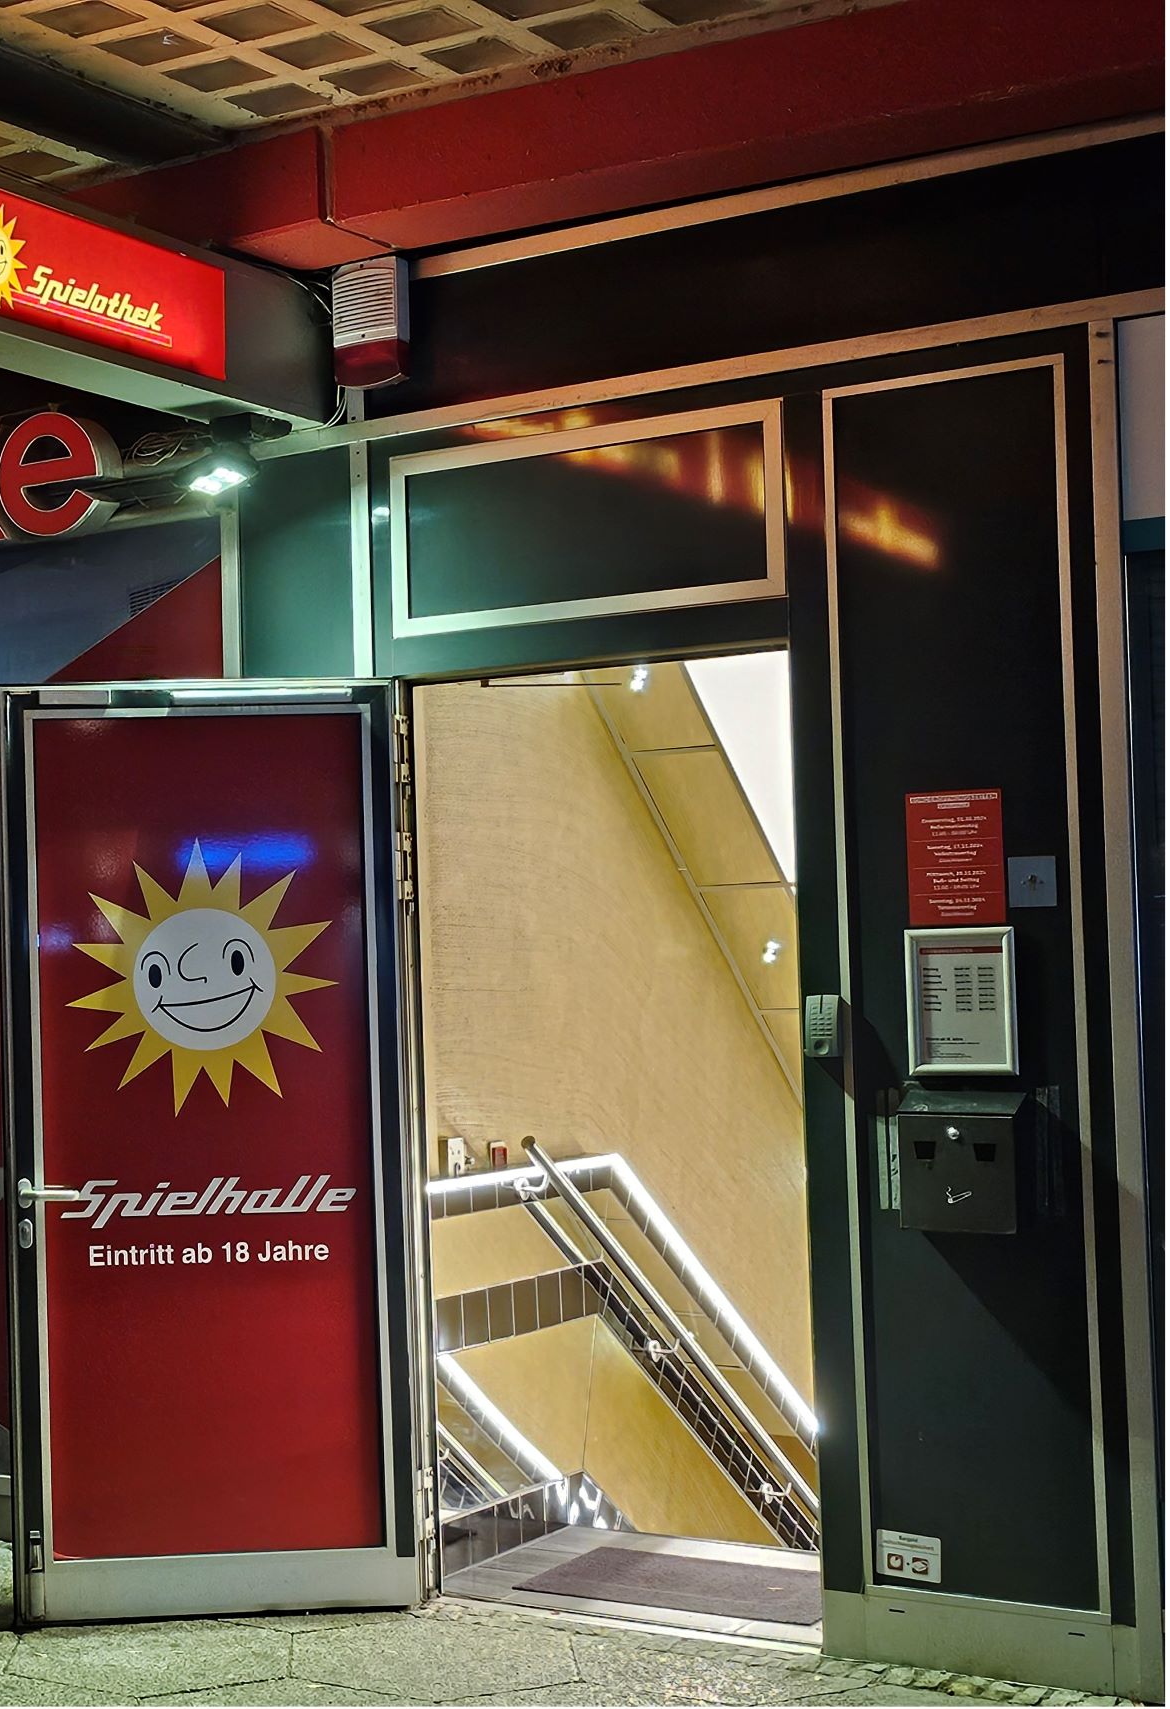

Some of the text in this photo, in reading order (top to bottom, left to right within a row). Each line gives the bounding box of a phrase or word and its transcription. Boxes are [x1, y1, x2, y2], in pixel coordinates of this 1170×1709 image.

[25, 265, 164, 333] Spielothek
[60, 1174, 358, 1230] Spielhalle
[88, 1240, 330, 1267] Eintritt ab 18 Jahre
